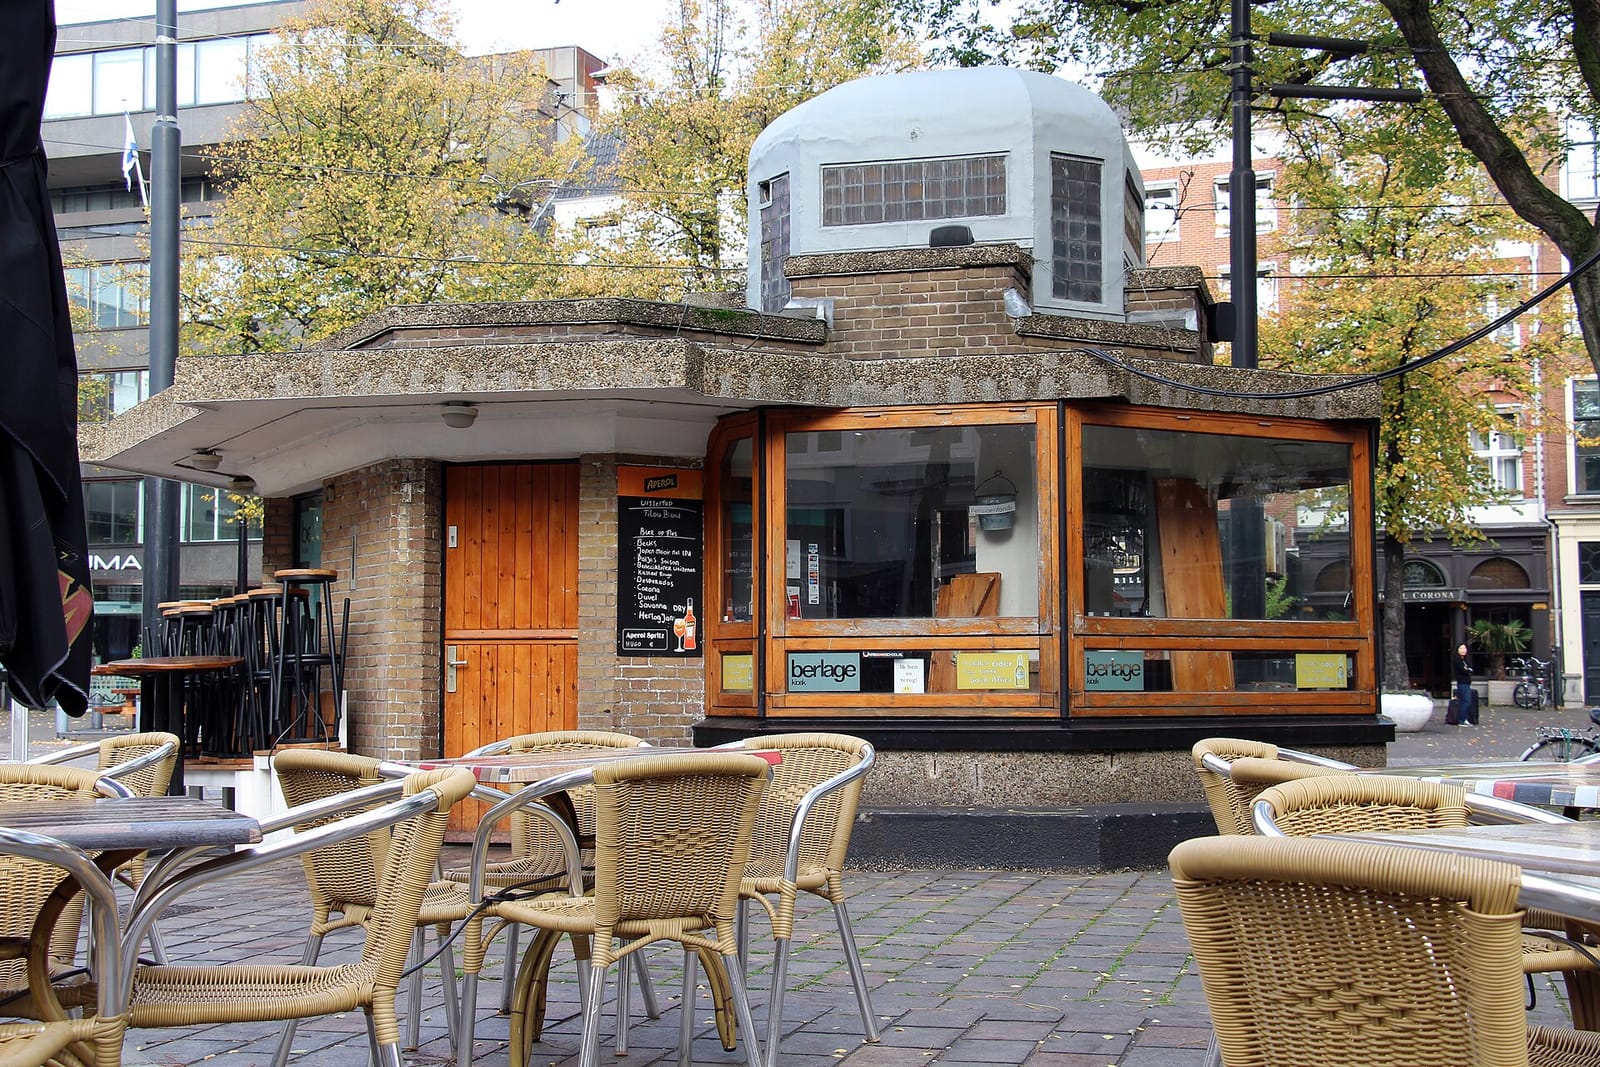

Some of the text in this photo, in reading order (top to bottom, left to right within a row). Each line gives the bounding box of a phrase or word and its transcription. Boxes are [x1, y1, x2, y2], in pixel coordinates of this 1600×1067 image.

[637, 592, 658, 601] Duvel
[672, 604, 686, 614] DRY
[646, 632, 665, 640] Spritz
[791, 659, 857, 682] berlage
[1086, 657, 1141, 681] berlage
